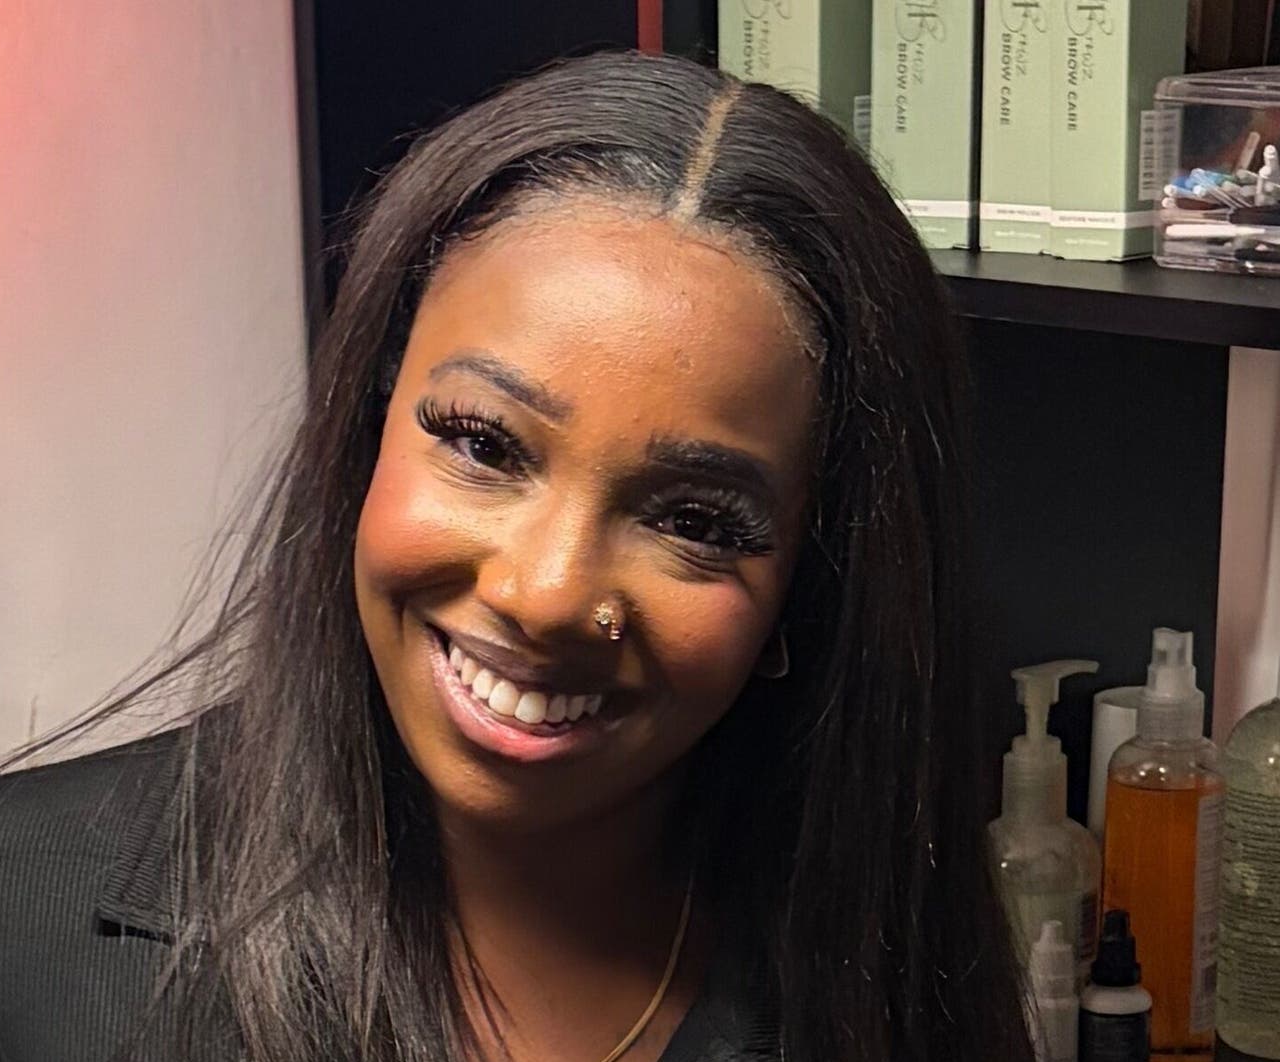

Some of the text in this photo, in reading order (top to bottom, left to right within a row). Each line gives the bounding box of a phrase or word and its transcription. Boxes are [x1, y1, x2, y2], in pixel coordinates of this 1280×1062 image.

[743, 20, 754, 77] BROW
[896, 42, 908, 134] BROW CARE
[999, 32, 1012, 126] BROW CARE
[1067, 37, 1078, 131] BROW CARE
